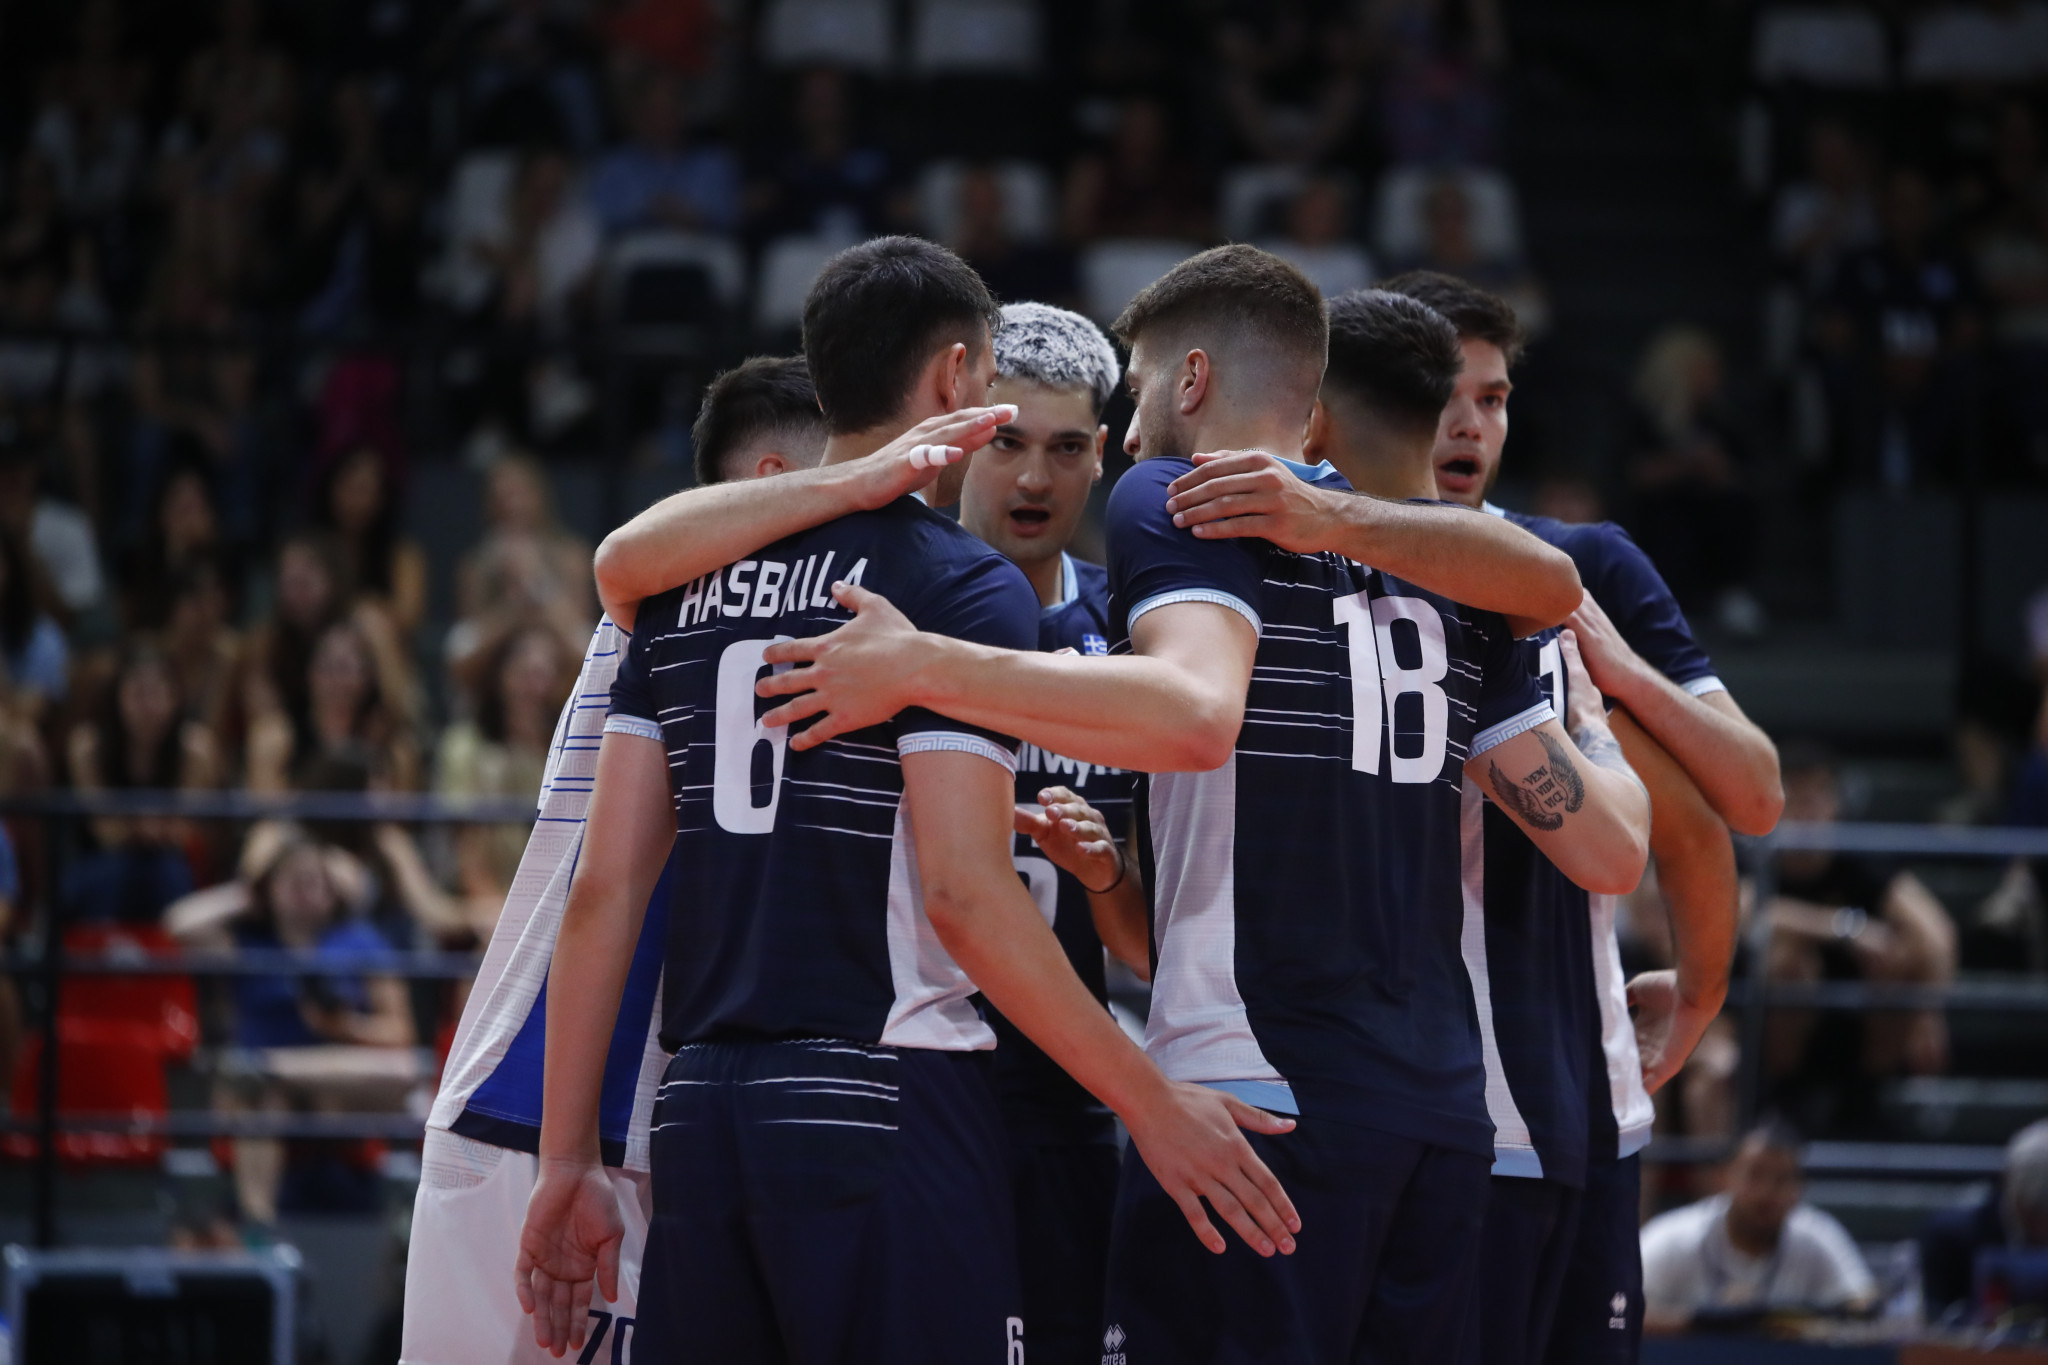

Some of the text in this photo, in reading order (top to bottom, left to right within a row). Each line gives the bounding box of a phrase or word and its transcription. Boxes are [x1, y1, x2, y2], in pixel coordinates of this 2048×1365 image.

[1333, 590, 1448, 783] 18
[713, 634, 796, 834] 6
[1523, 765, 1548, 785] VENI
[1536, 778, 1555, 796] VIDI
[1544, 791, 1564, 808] VICI
[1006, 1316, 1025, 1365] 6
